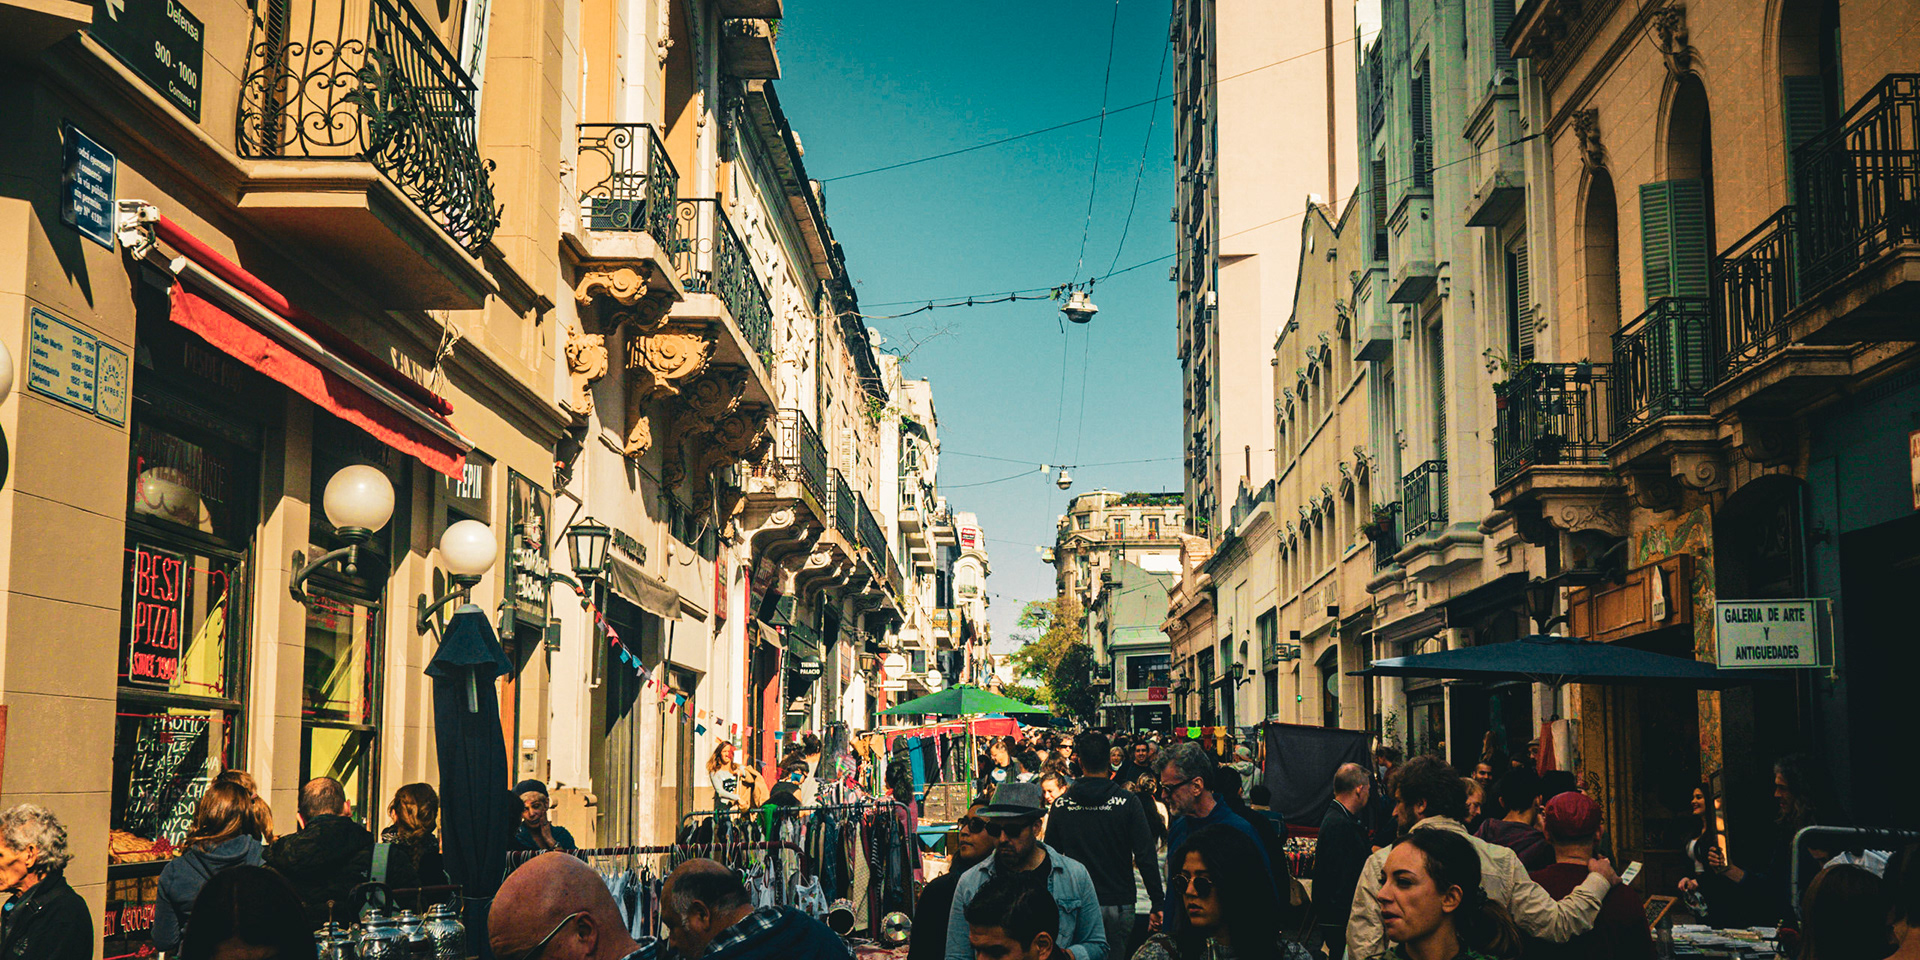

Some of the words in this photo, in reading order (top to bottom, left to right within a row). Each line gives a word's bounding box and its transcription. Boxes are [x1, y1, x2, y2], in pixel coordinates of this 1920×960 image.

[167, 0, 199, 41] Defensa
[155, 41, 171, 67] 900
[178, 61, 197, 89] 1000
[169, 80, 192, 108] Comuna
[193, 100, 197, 111] 1
[32, 372, 51, 387] Defensa
[138, 552, 182, 602] BEST
[134, 601, 178, 650] PIZZA
[1724, 608, 1763, 623] GALERIA
[1768, 608, 1779, 622] DE
[1783, 608, 1805, 622] ARTE
[1763, 627, 1770, 640] Y
[132, 652, 156, 678] SINCE
[800, 661, 819, 669] TIENDA
[1735, 645, 1799, 660] ANTIGUEDADES
